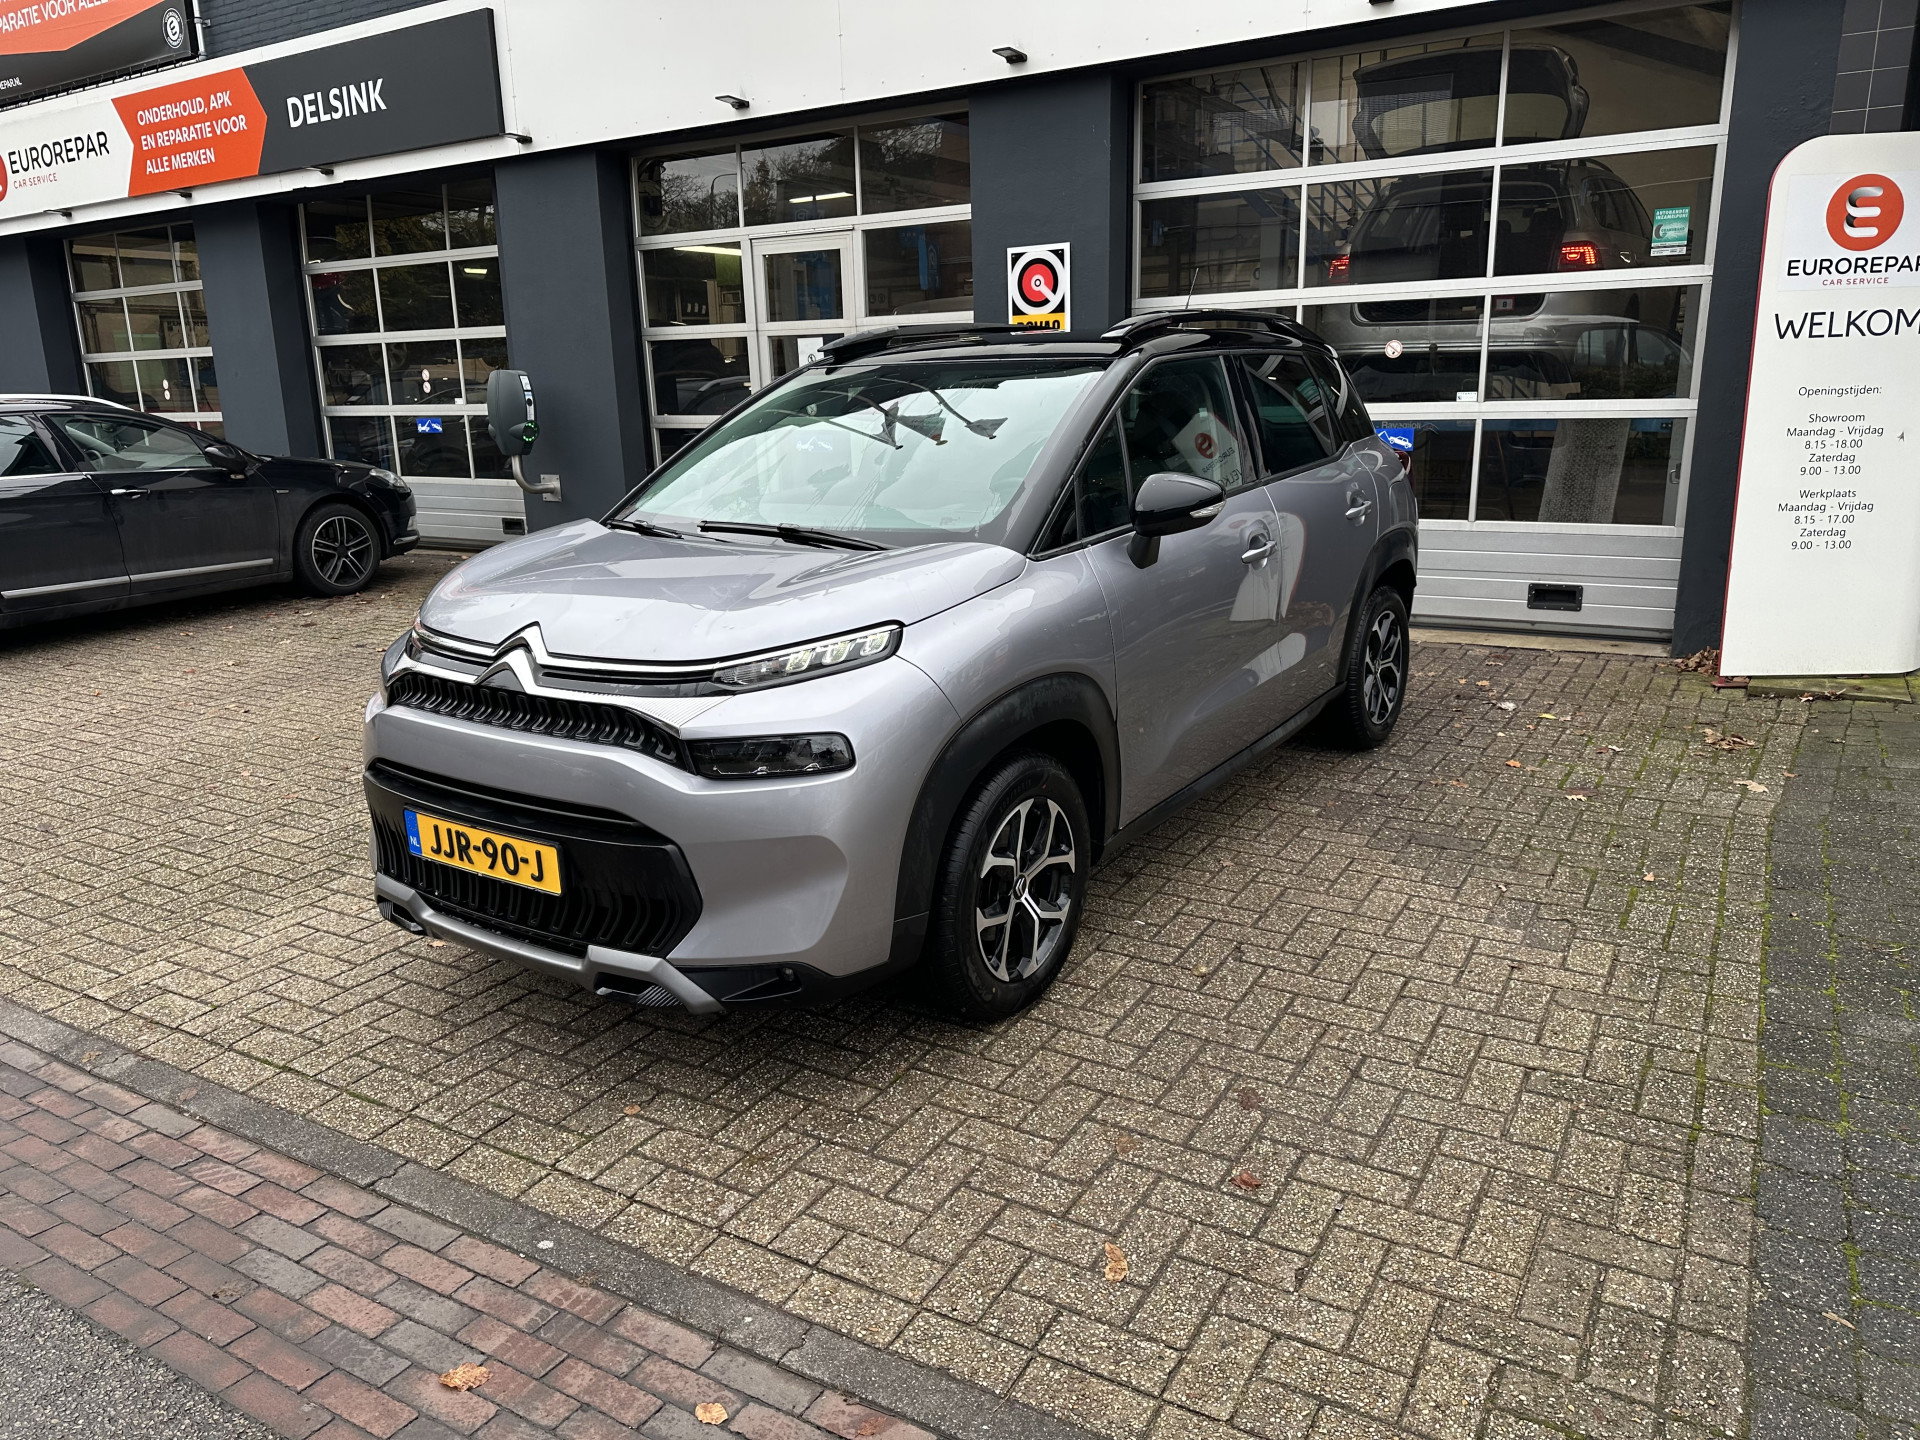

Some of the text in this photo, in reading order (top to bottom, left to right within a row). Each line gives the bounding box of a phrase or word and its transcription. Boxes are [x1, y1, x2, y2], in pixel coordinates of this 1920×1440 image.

[40, 0, 77, 21] VOOR
[137, 91, 232, 126] ONDERHOUD, APK
[286, 78, 388, 128] DELSINK
[141, 114, 248, 151] EN REPARATIE VOOR
[8, 131, 110, 174] EUROREPAR
[146, 147, 216, 175] ALLE MERKEN
[13, 172, 58, 189] CAR SERVICE
[1846, 277, 1889, 286] SERVICE
[1774, 308, 1920, 340] WELKOM
[1798, 385, 1882, 398] Openingstijden:
[1808, 413, 1866, 423] Showroom
[1786, 427, 1836, 438] Maandag
[1847, 425, 1884, 437] Vrijdag
[1804, 440, 1826, 450] 8.15
[1808, 452, 1856, 464] Zaterdag
[1800, 466, 1822, 476] 9.00
[1833, 465, 1861, 475] 13.00
[1799, 489, 1857, 500] Werkplaats
[1777, 502, 1827, 513] Maandag
[1837, 501, 1874, 513] Vrijdag
[1794, 515, 1815, 525] 8.15
[1827, 514, 1855, 524] 17.00
[1800, 527, 1846, 539] Zaterdag
[1791, 540, 1813, 550] 9.00
[1824, 539, 1852, 550] 13.00
[409, 835, 420, 847] NL
[430, 824, 544, 882] JJR-90-J
